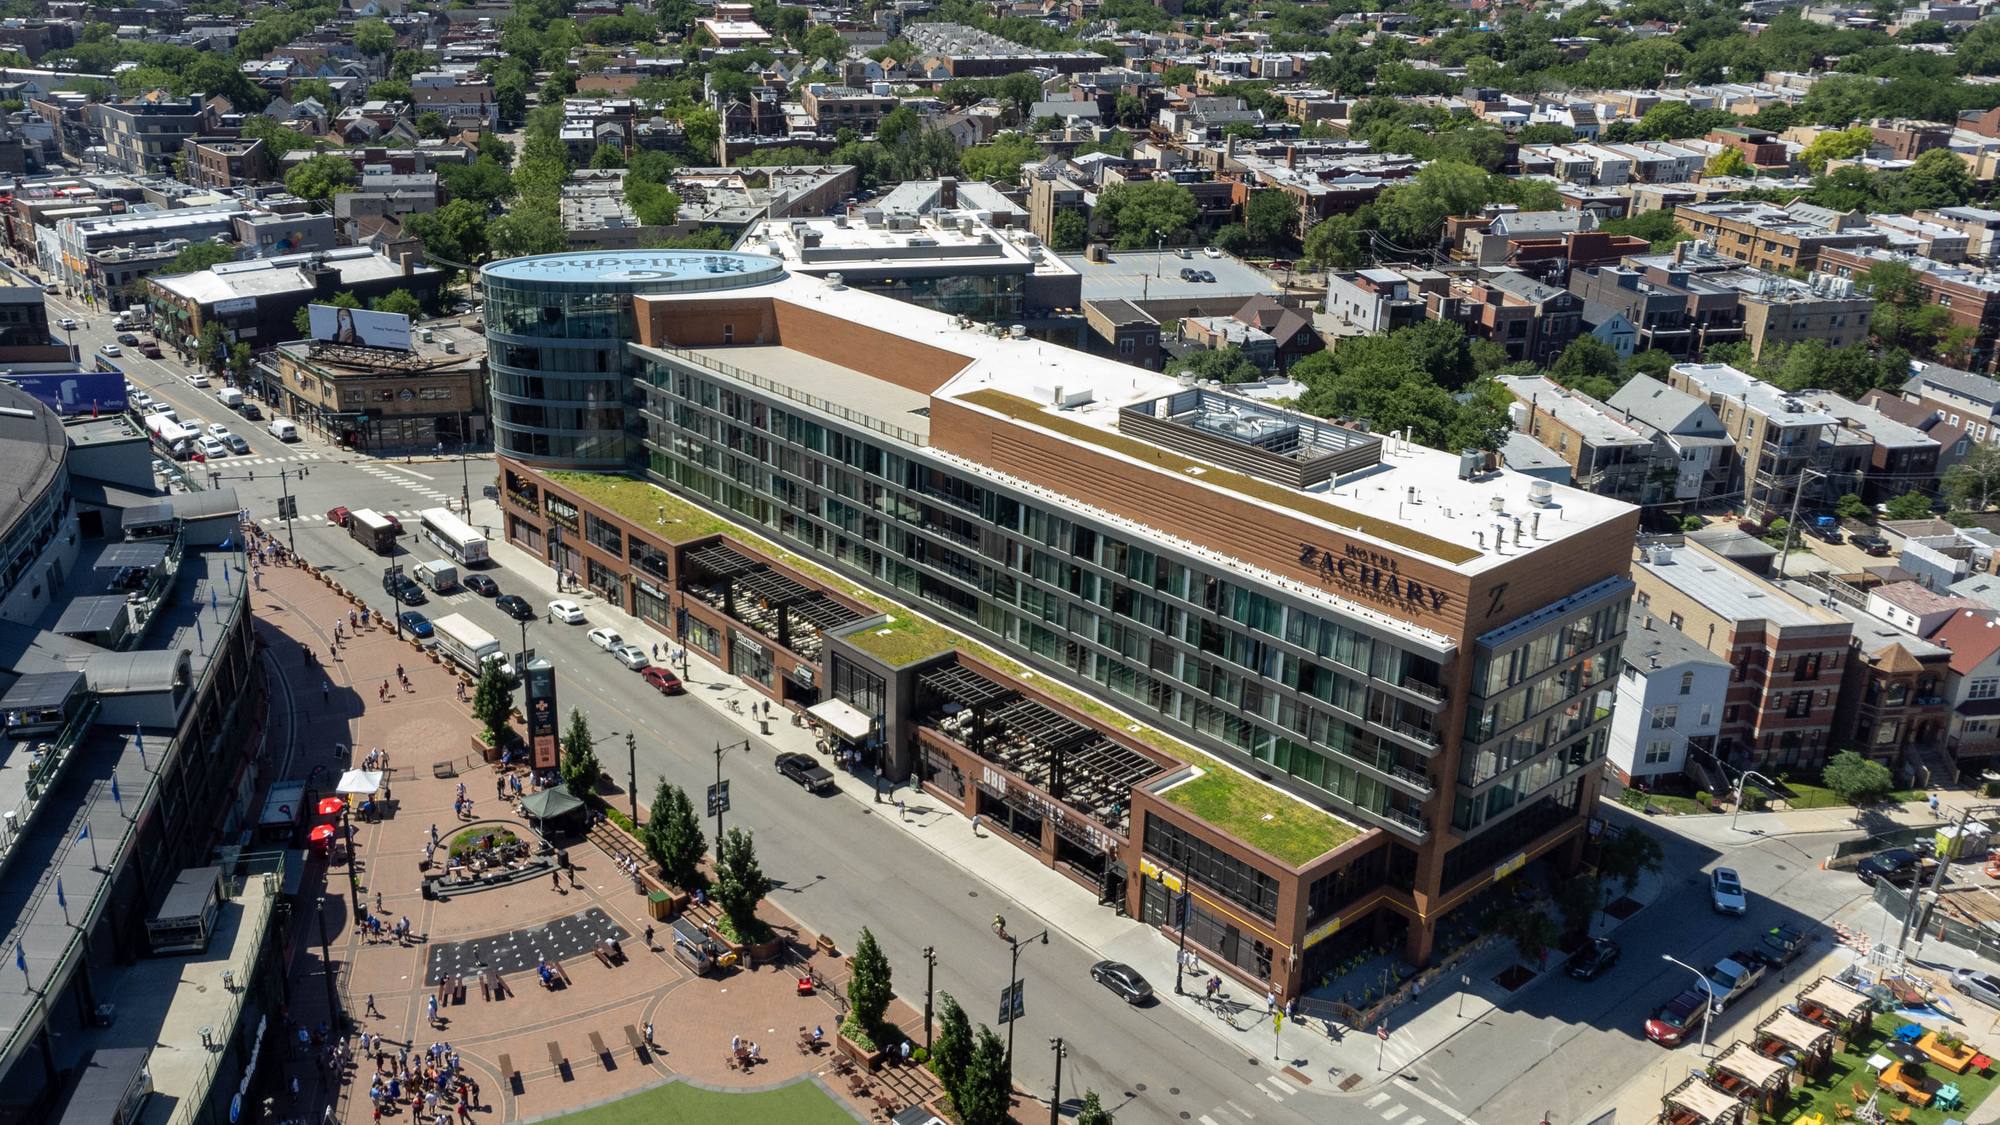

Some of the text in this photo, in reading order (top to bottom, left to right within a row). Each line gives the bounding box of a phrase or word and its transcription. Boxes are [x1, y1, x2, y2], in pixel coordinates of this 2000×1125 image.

[1345, 543, 1398, 570] HOTEL
[1298, 543, 1449, 613] ZACHARY
[1485, 582, 1508, 618] Z
[983, 766, 1007, 794] BBQ
